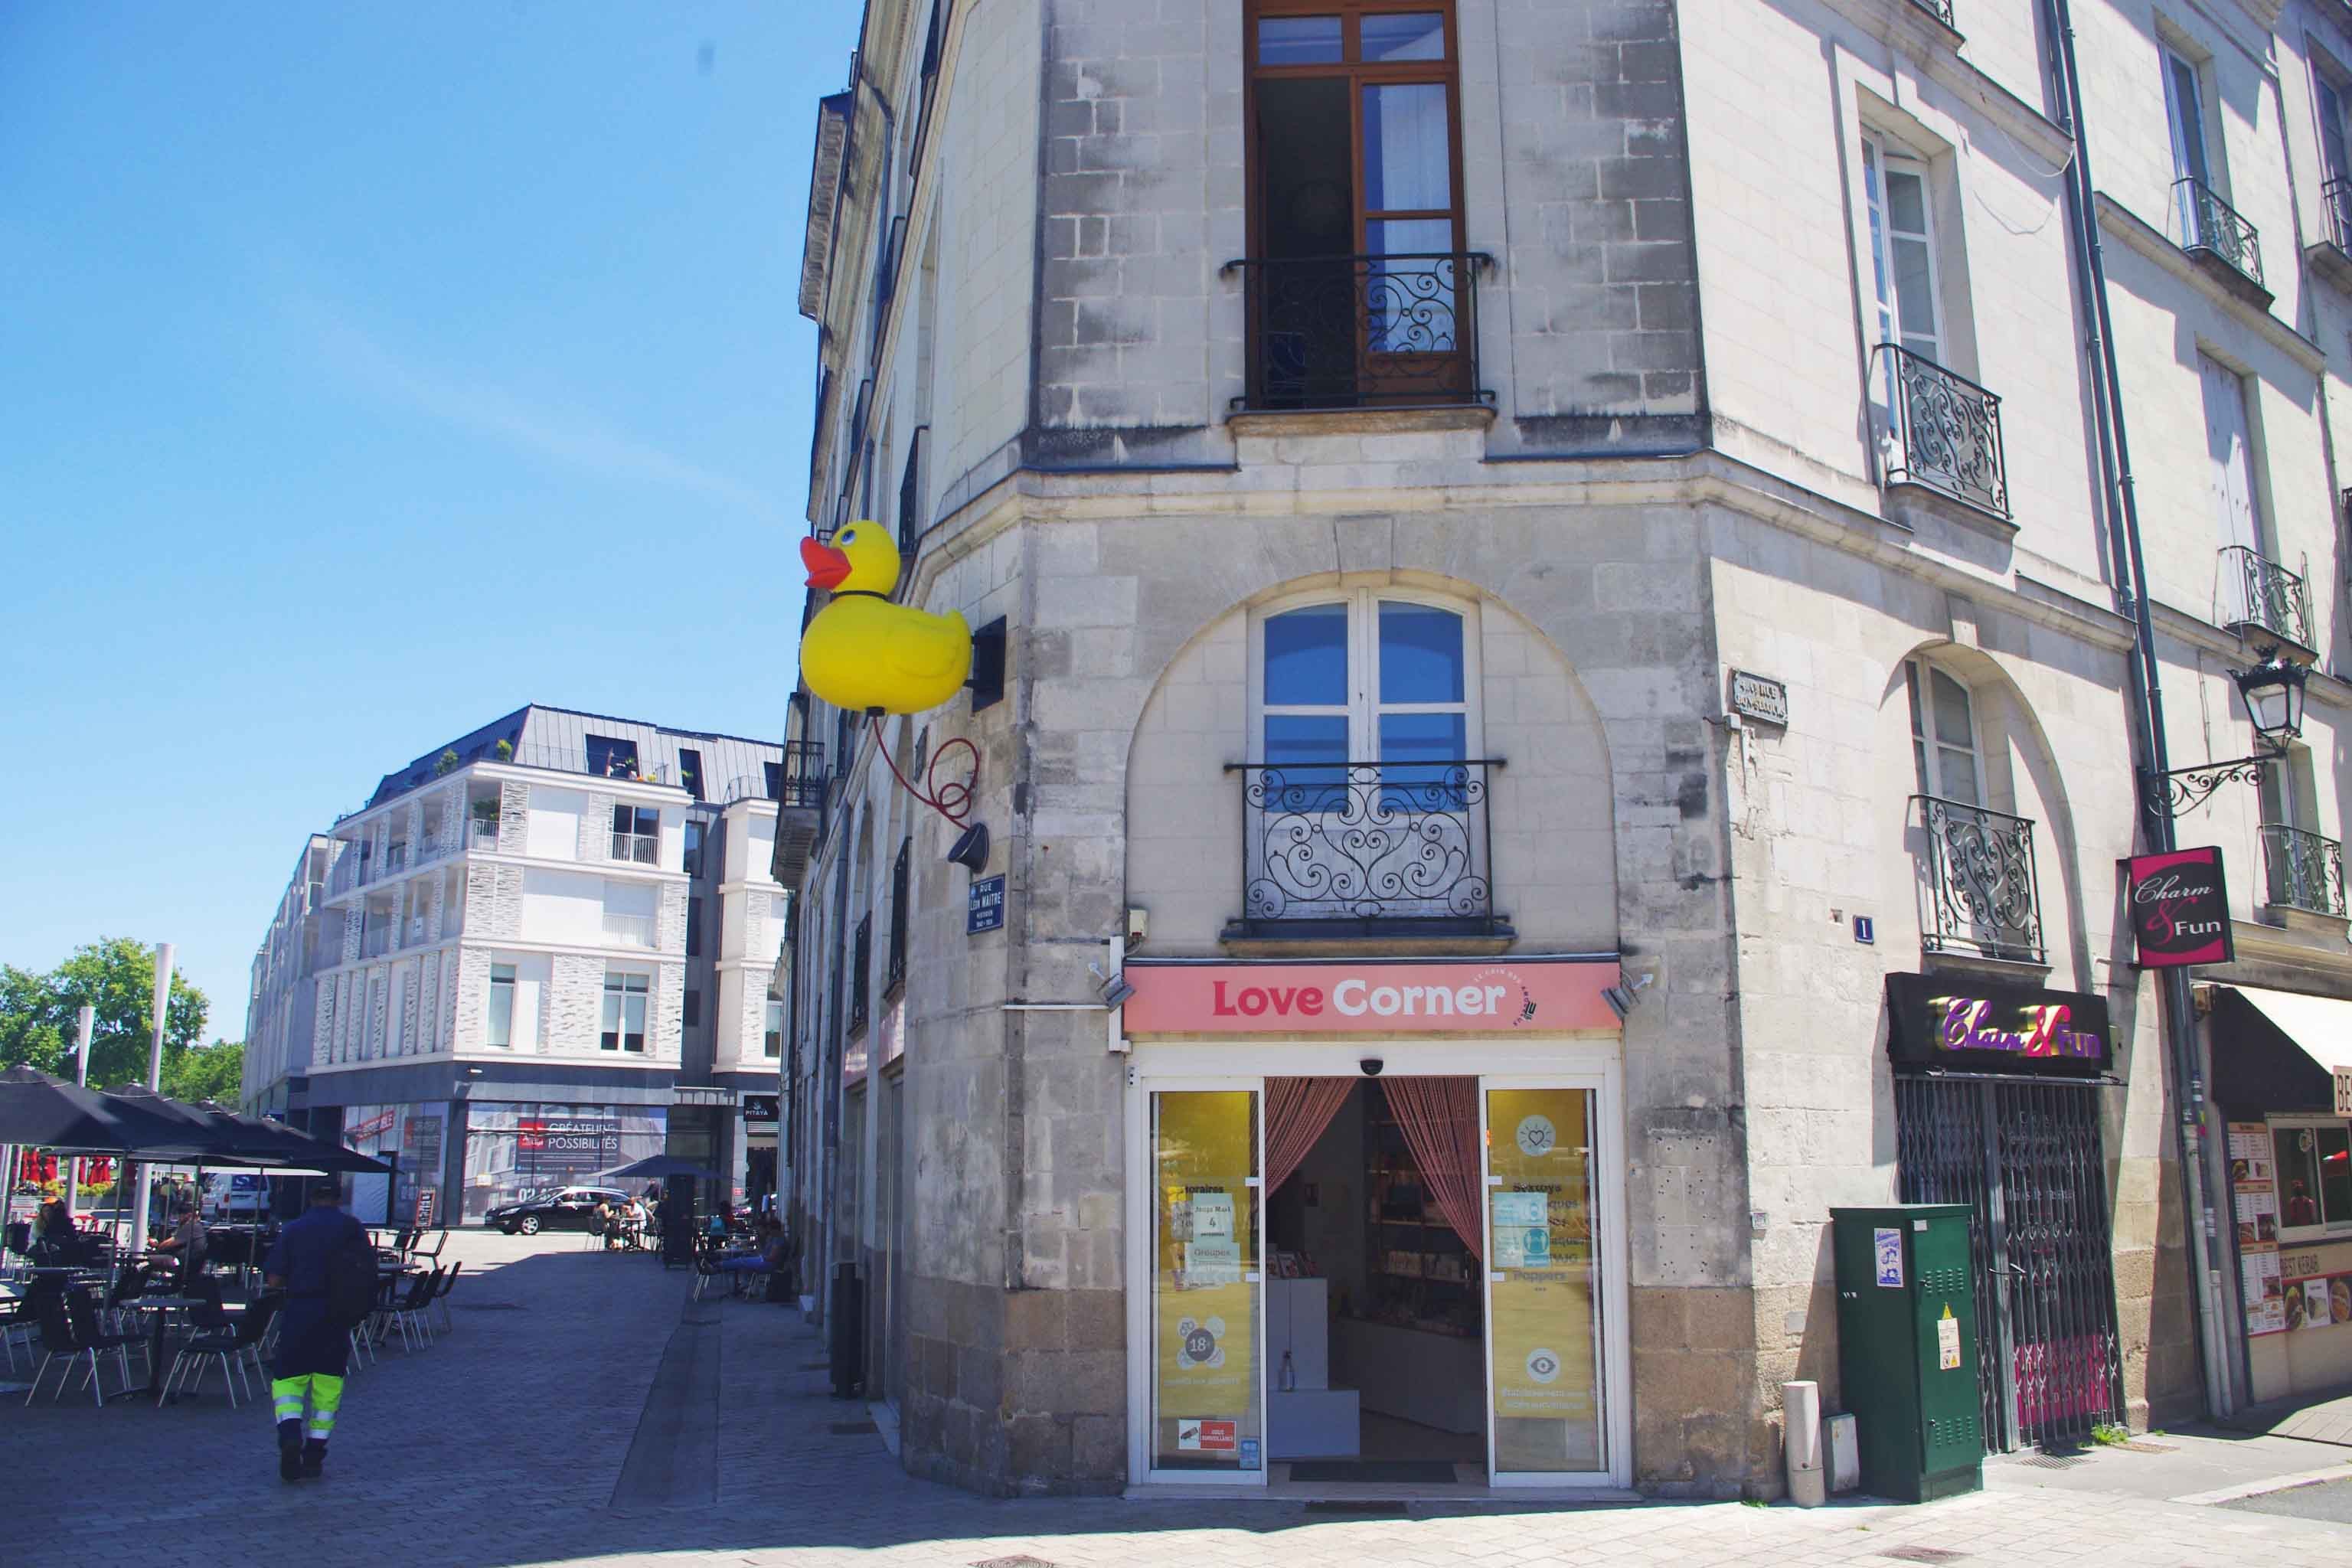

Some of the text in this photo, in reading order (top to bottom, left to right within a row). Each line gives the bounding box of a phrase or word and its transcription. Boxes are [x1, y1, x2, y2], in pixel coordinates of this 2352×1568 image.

[2135, 875, 2213, 903] Charm
[2175, 921, 2221, 936] Fun
[1213, 979, 1506, 1016] Love Corner
[2337, 1075, 2352, 1111] BE
